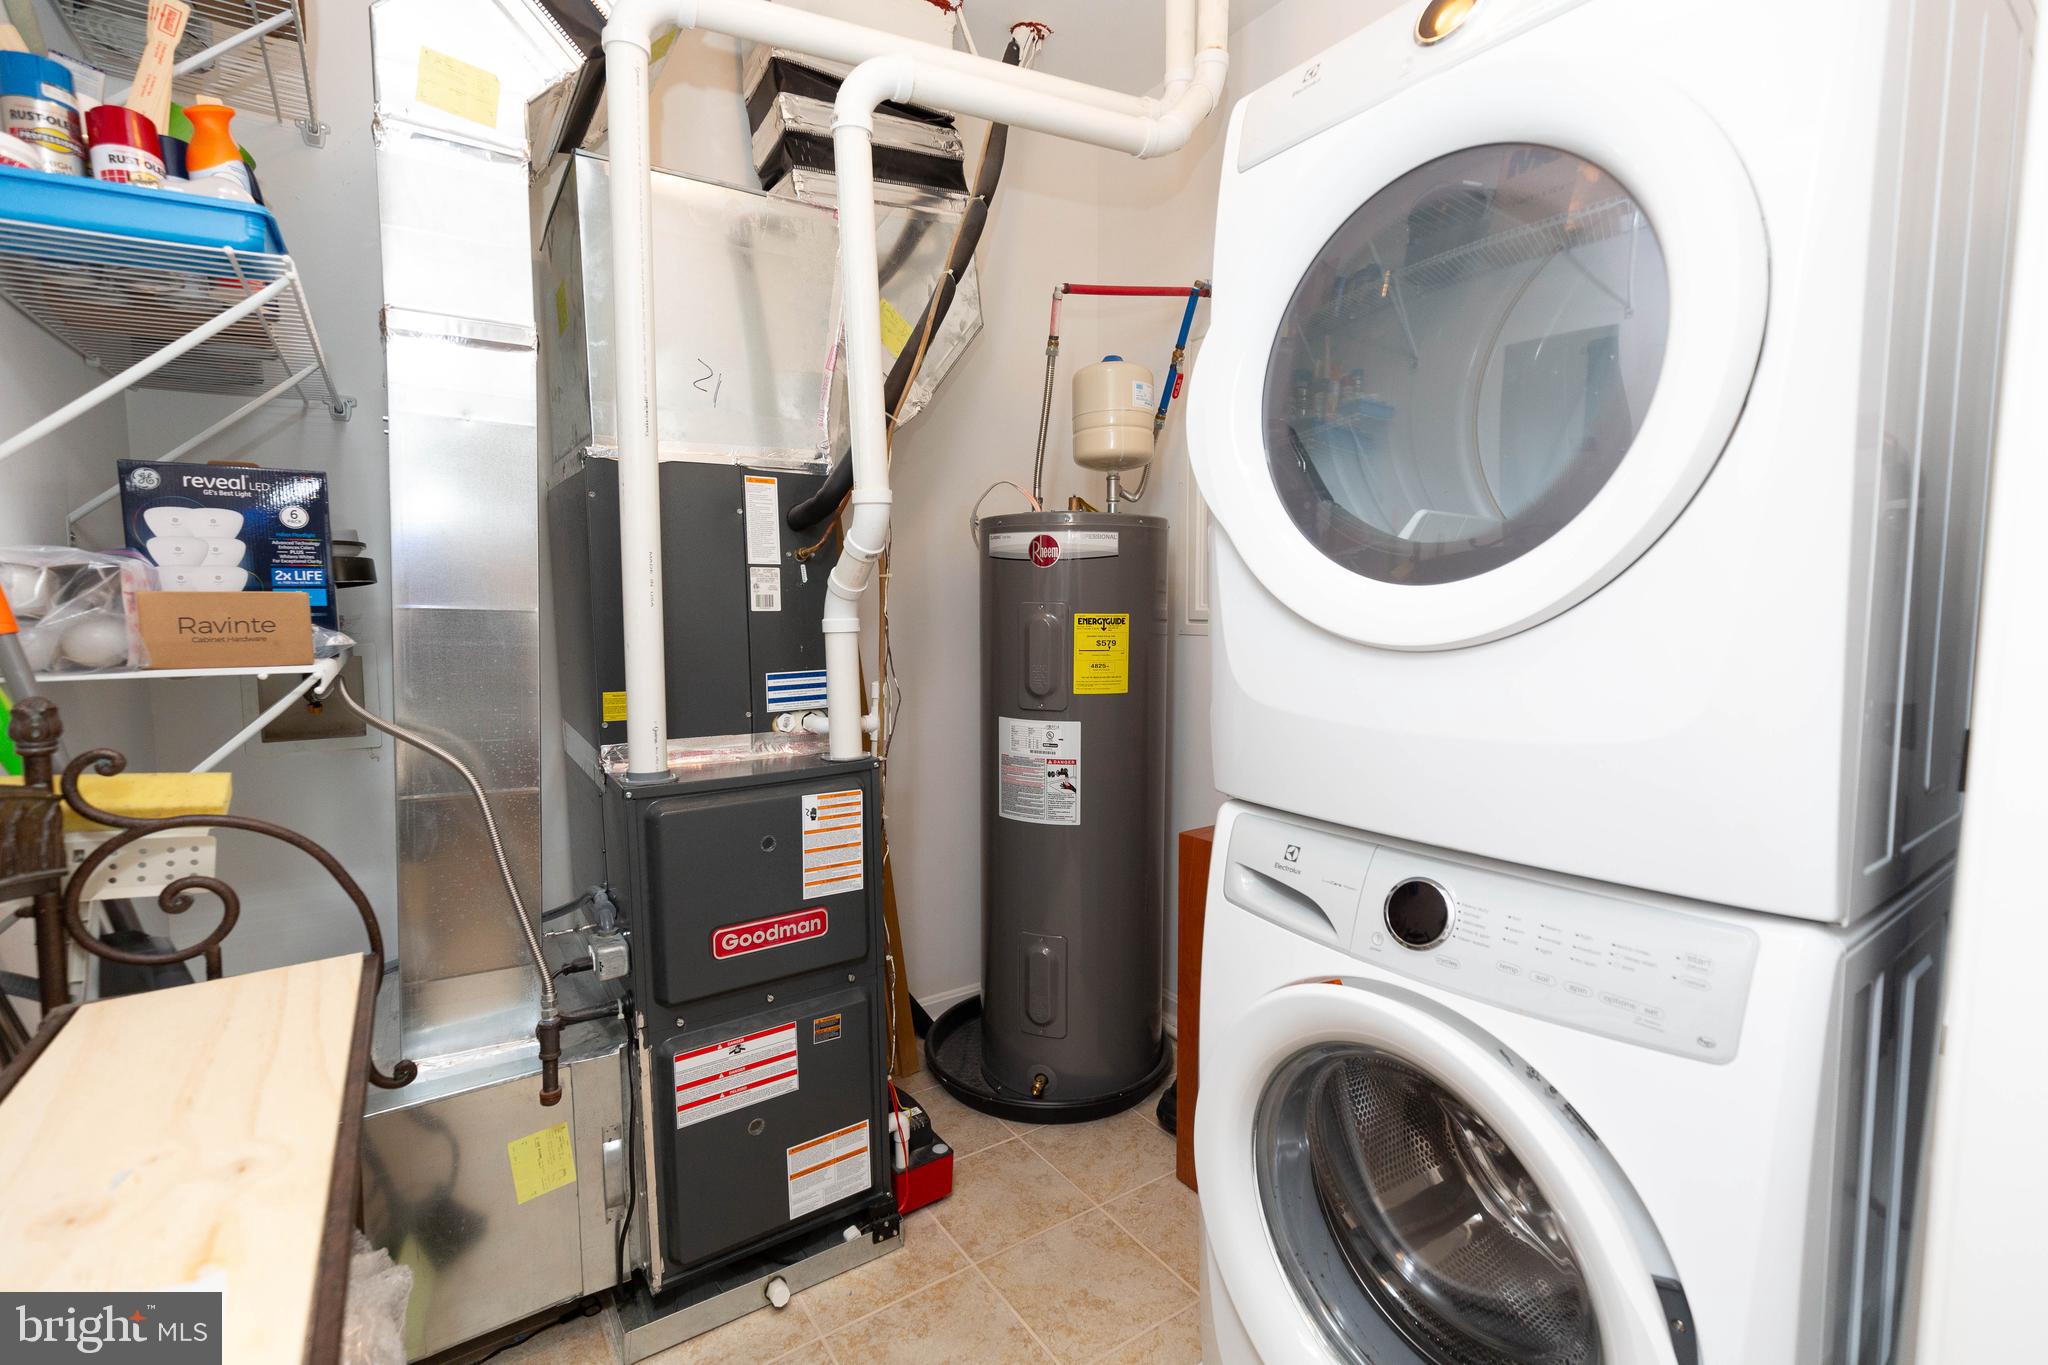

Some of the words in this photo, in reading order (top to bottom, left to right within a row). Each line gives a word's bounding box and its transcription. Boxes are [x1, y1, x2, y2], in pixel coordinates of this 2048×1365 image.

[182, 474, 246, 491] reveal
[248, 482, 272, 492] LED
[234, 491, 252, 499] Light
[290, 509, 299, 520] 6
[1032, 534, 1060, 563] Rheem
[274, 570, 292, 581] 2x
[294, 570, 323, 581] LIFE
[178, 617, 277, 635] Ravinte
[1077, 617, 1126, 626] ENERGYGUIDE
[1095, 639, 1117, 647] $579
[1274, 861, 1302, 876] Electrolux
[721, 918, 822, 951] Goodman
